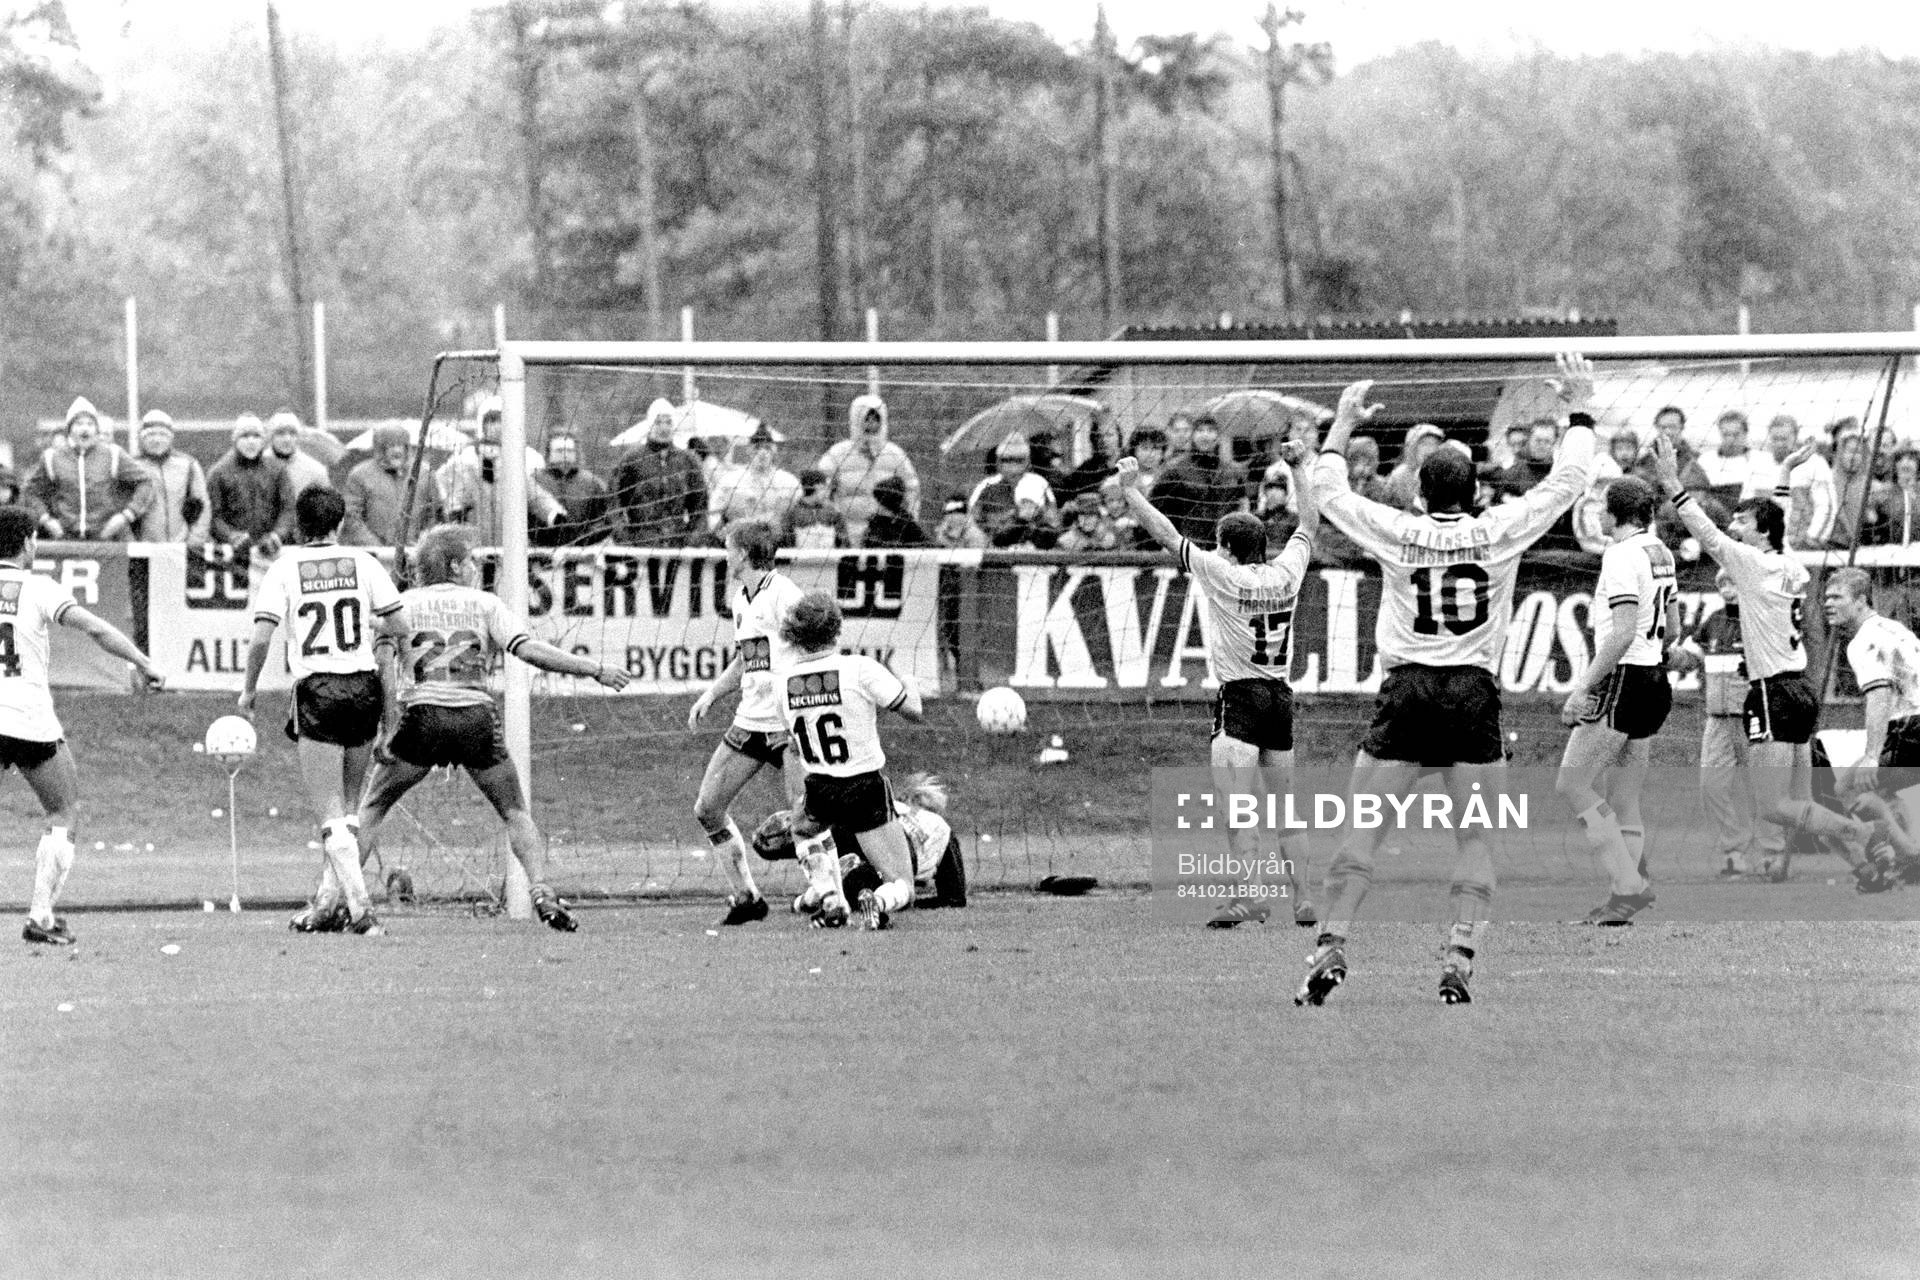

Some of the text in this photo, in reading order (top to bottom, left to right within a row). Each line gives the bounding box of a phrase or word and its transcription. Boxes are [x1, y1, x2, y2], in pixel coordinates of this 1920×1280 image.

[302, 577, 356, 592] SECURITAS
[1410, 562, 1490, 636] 10
[297, 597, 362, 657] 20
[1249, 610, 1293, 666] 17
[411, 630, 482, 685] 22
[790, 692, 841, 709] SECURITAS
[792, 712, 850, 766] 16
